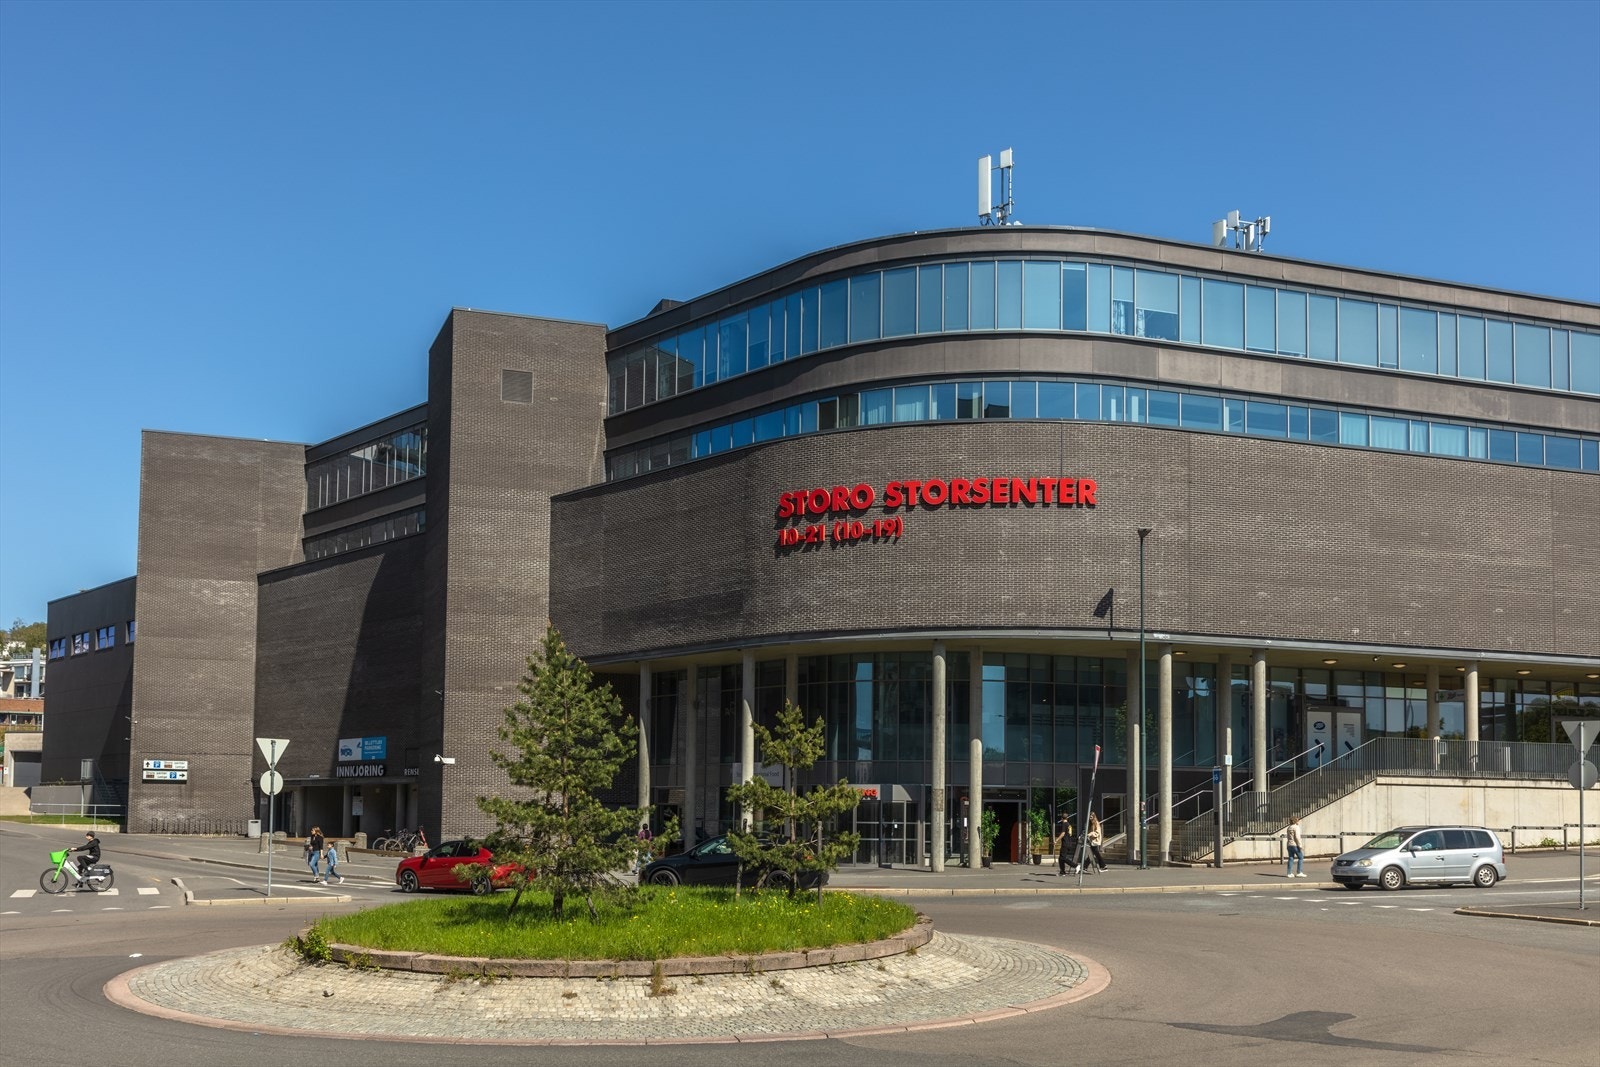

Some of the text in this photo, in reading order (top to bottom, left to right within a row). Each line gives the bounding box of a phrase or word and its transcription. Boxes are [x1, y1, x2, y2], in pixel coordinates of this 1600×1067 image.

[779, 477, 1097, 517] STORO STORSENTER
[778, 515, 904, 546] 10-21 (10-19)
